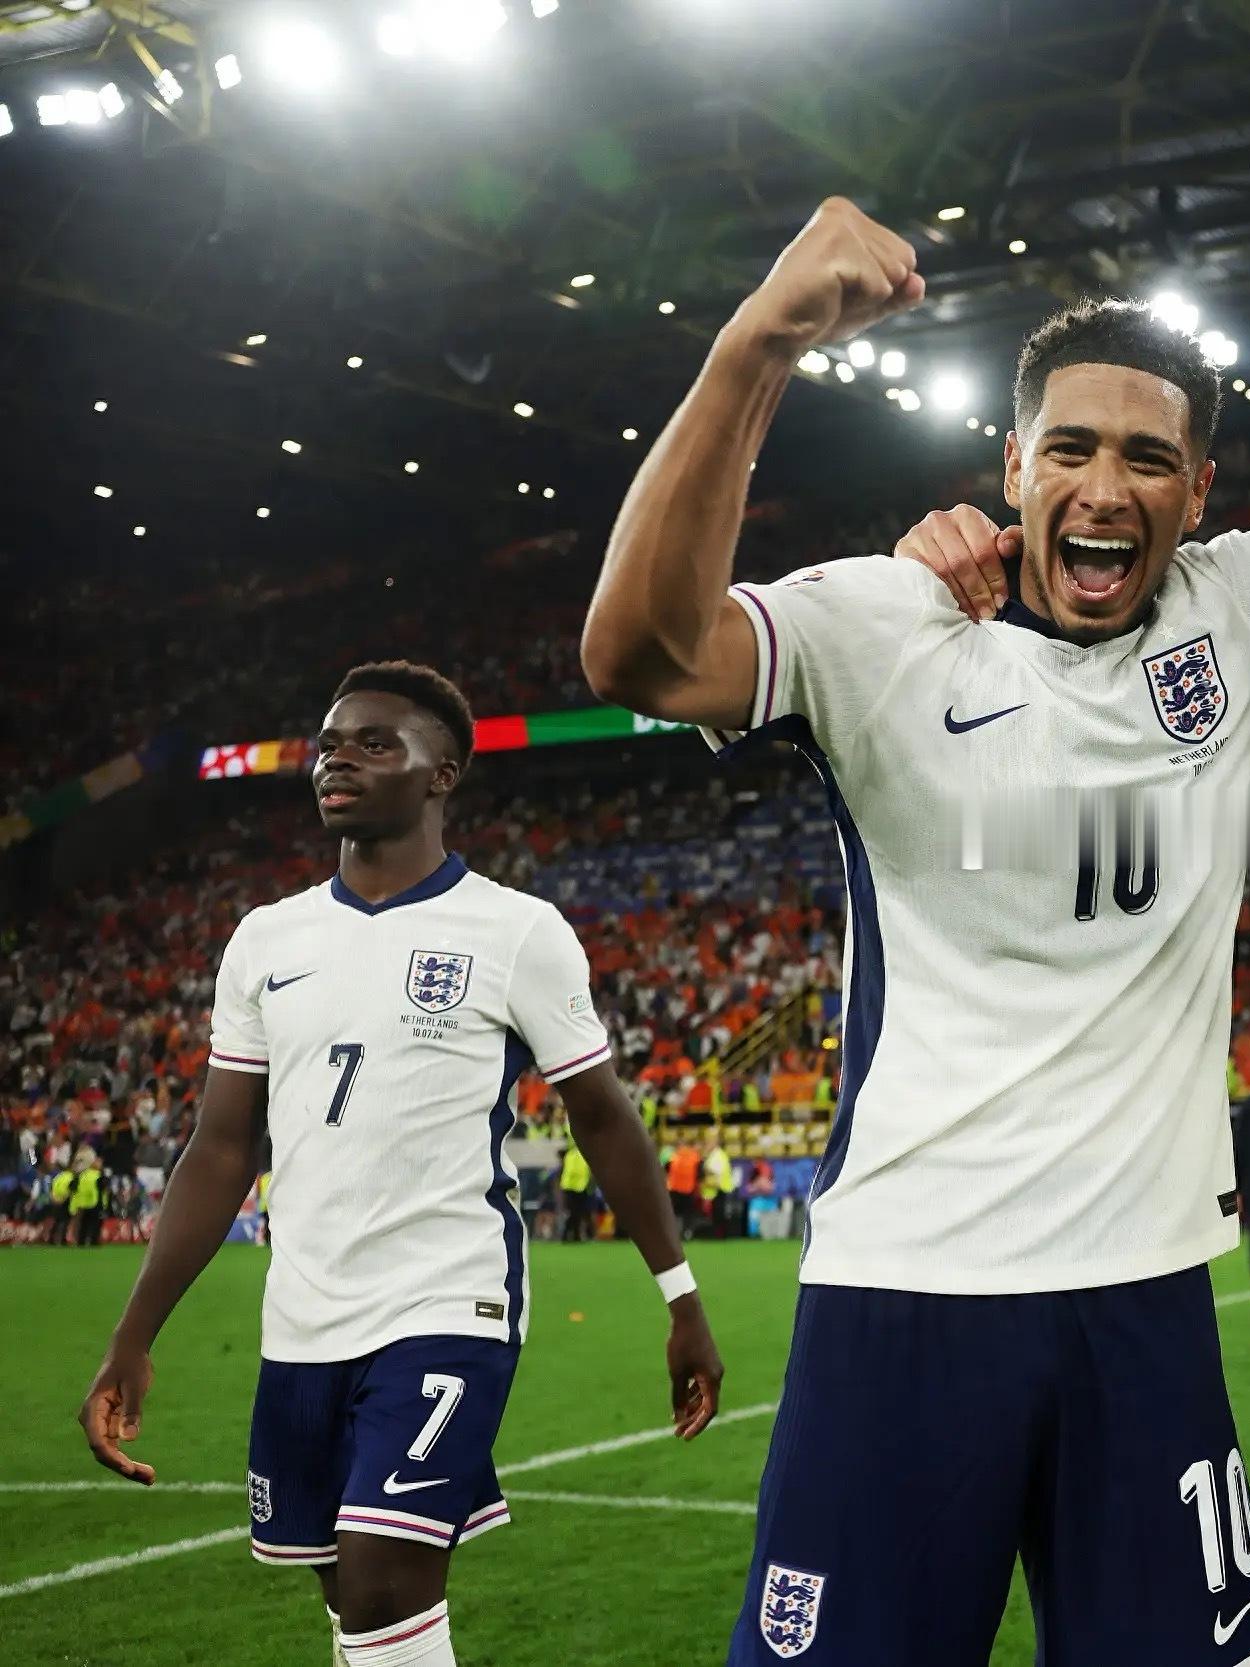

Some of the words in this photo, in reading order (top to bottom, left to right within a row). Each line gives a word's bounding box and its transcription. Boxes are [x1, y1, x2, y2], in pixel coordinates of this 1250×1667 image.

[1168, 737, 1232, 765] NETHERLAN
[400, 1014, 459, 1029] NETHERLANDS
[412, 1027, 443, 1039] 10.07.24
[326, 1043, 365, 1127] 7
[407, 1373, 466, 1462] 7
